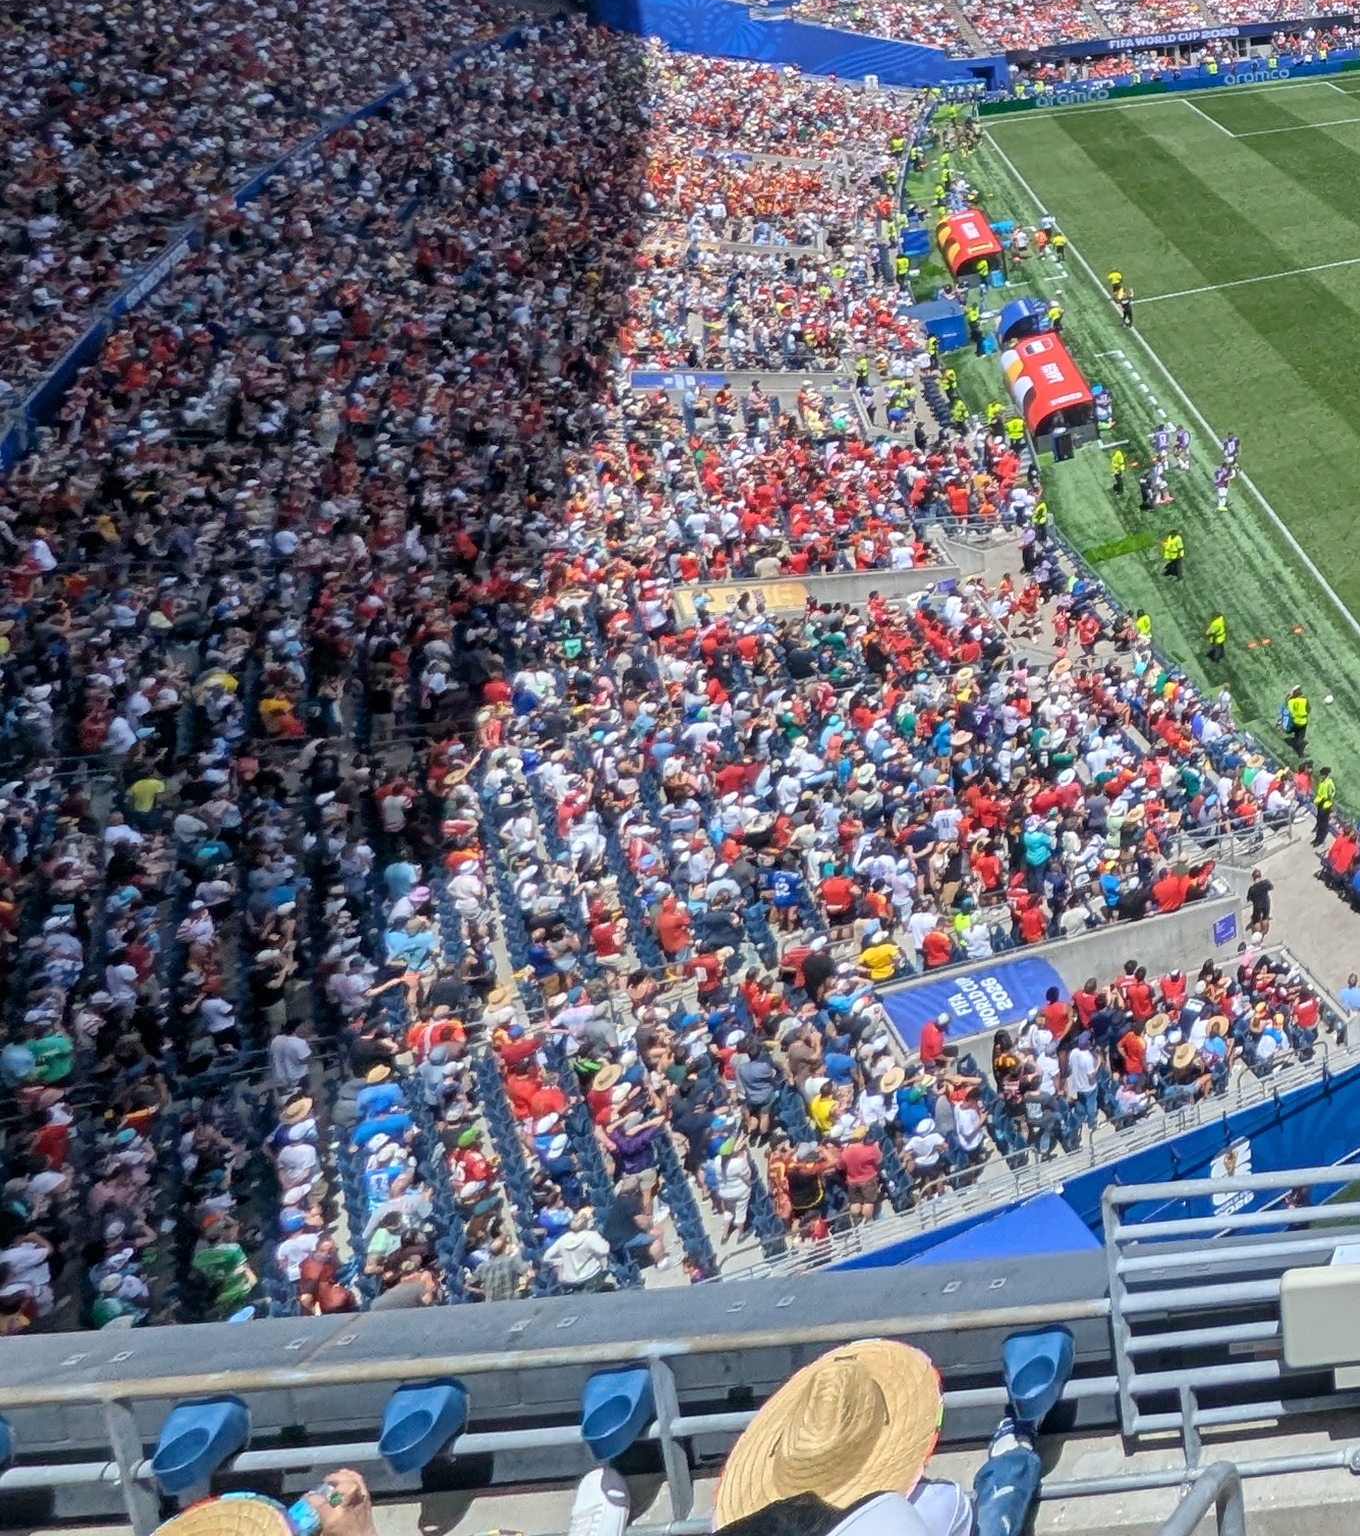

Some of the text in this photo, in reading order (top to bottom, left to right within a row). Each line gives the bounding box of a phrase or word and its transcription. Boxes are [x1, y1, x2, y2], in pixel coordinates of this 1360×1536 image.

[1109, 27, 1239, 50] FIFA WORLD CUP 2026
[1225, 67, 1291, 85] aramco
[1035, 87, 1110, 107] aramco
[948, 993, 973, 1016] FIFA
[981, 977, 1014, 1011] 2026
[969, 990, 1000, 1027] WORLD
